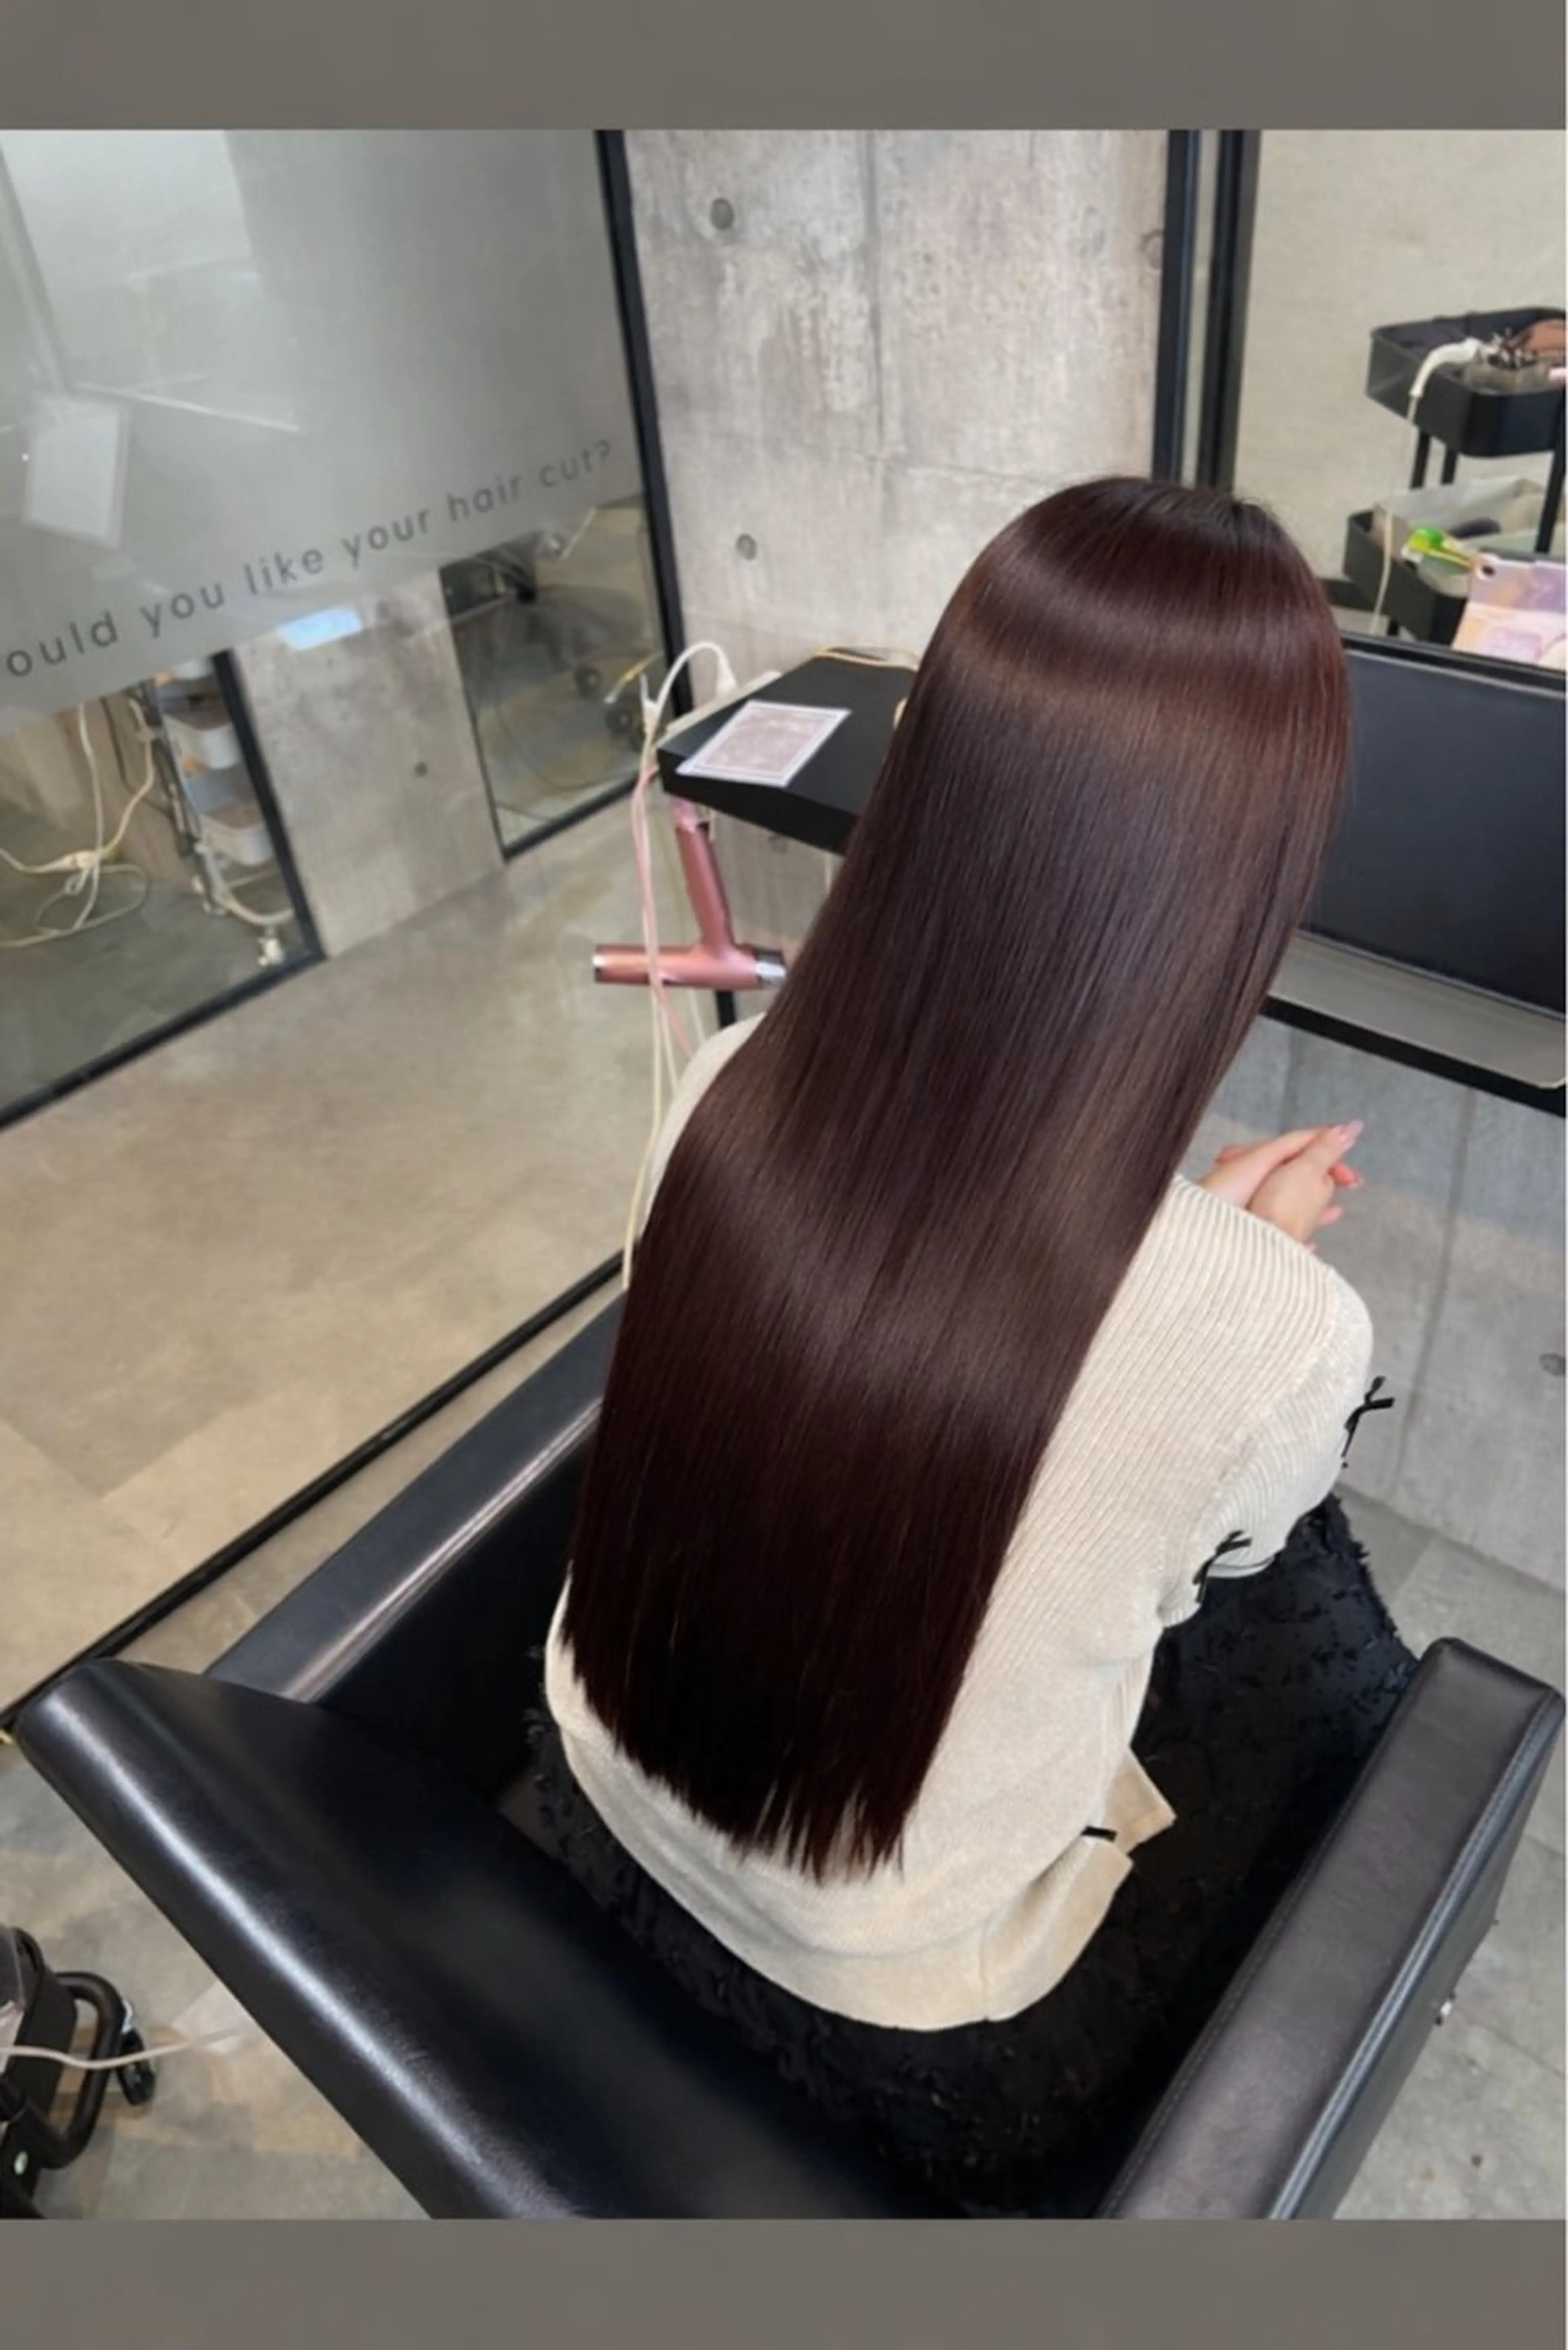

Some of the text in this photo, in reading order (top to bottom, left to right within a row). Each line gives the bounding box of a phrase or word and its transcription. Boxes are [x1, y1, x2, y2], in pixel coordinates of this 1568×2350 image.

[139, 583, 225, 639] you
[243, 548, 323, 595] like
[340, 508, 430, 570] your
[446, 474, 522, 522] hair
[539, 438, 611, 488] cut?
